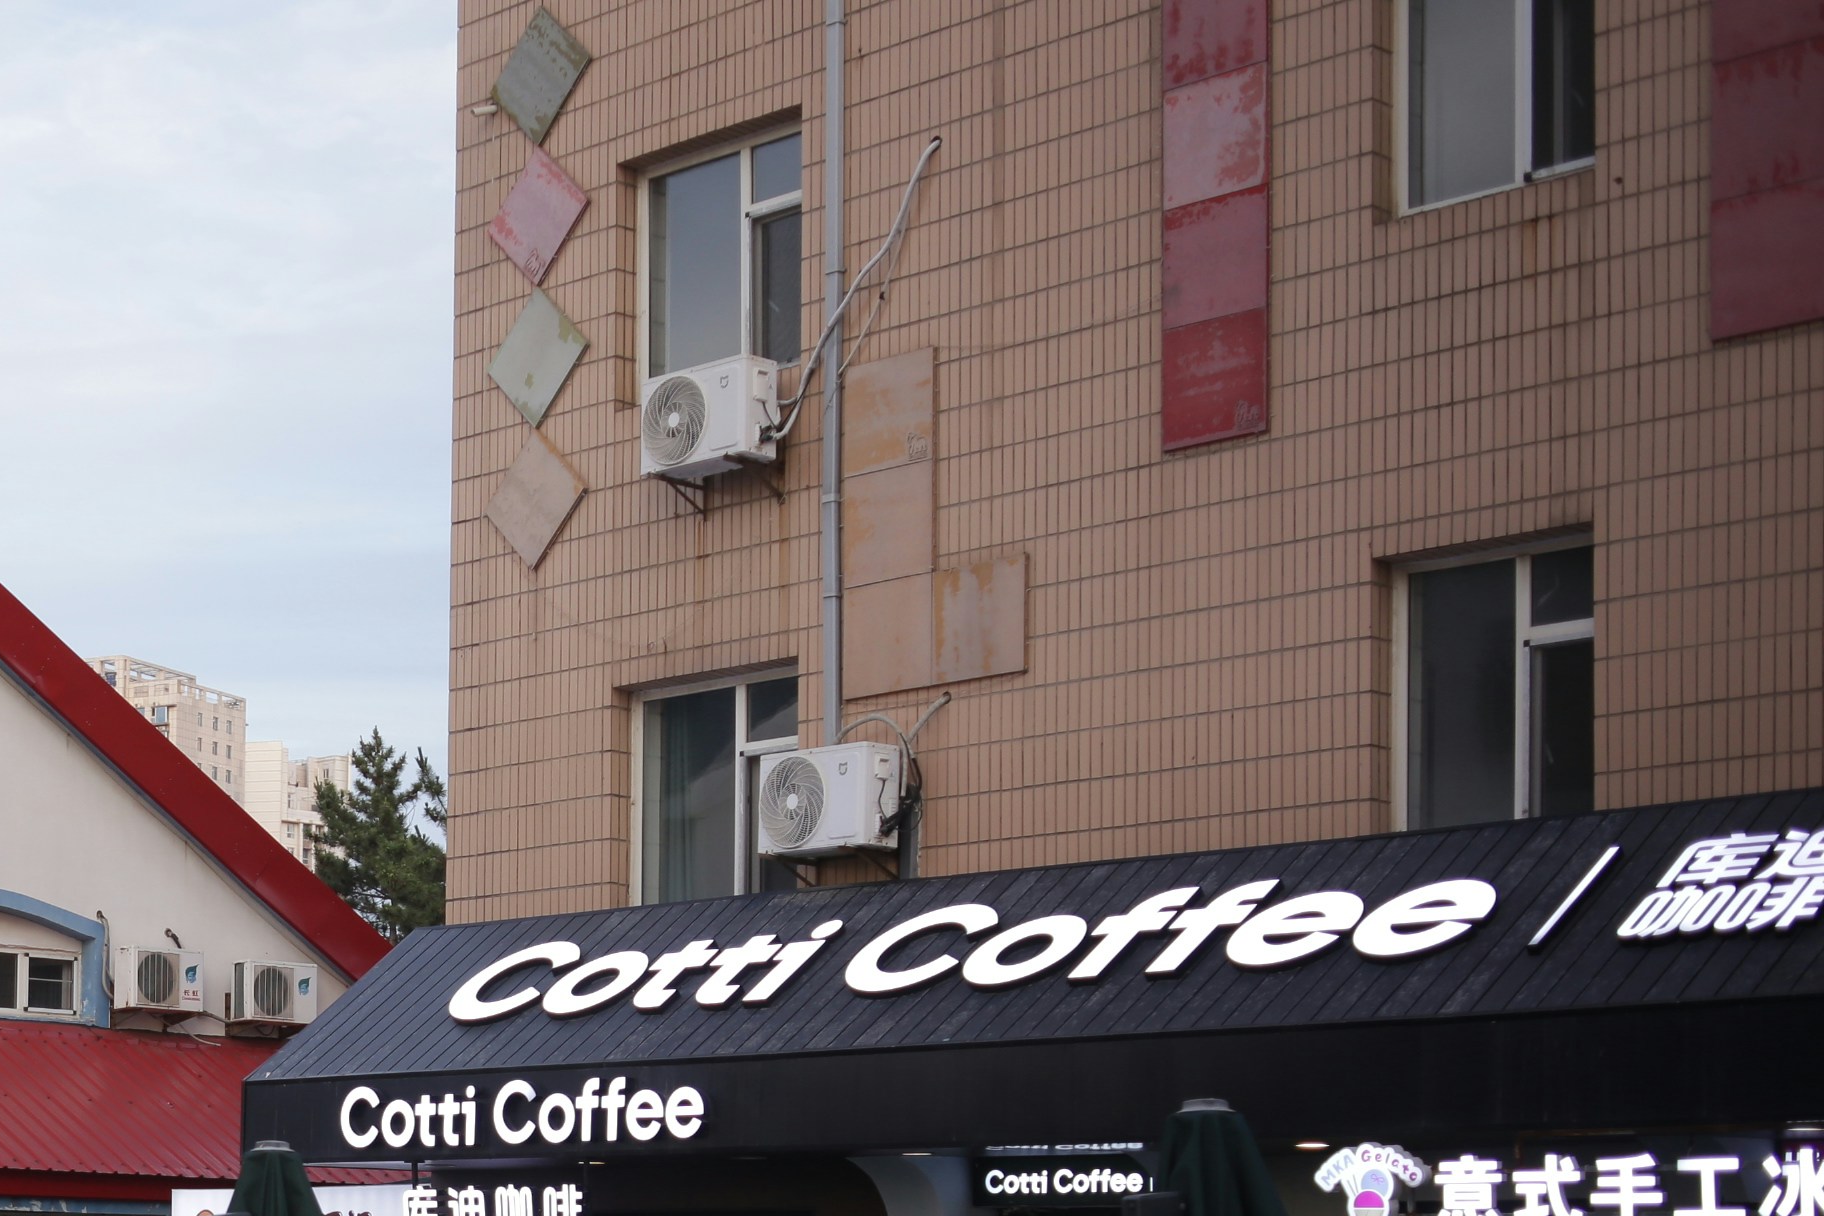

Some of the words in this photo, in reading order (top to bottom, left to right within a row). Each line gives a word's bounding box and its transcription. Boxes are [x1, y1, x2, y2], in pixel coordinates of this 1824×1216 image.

[449, 920, 843, 1022] Cotti
[844, 879, 1497, 994] Coffee
[340, 1085, 476, 1148] Cotti
[493, 1076, 705, 1145] Coffee
[985, 1169, 1048, 1194] Cotti
[1053, 1168, 1144, 1194] Coffee
[1361, 1150, 1418, 1181] Gelato
